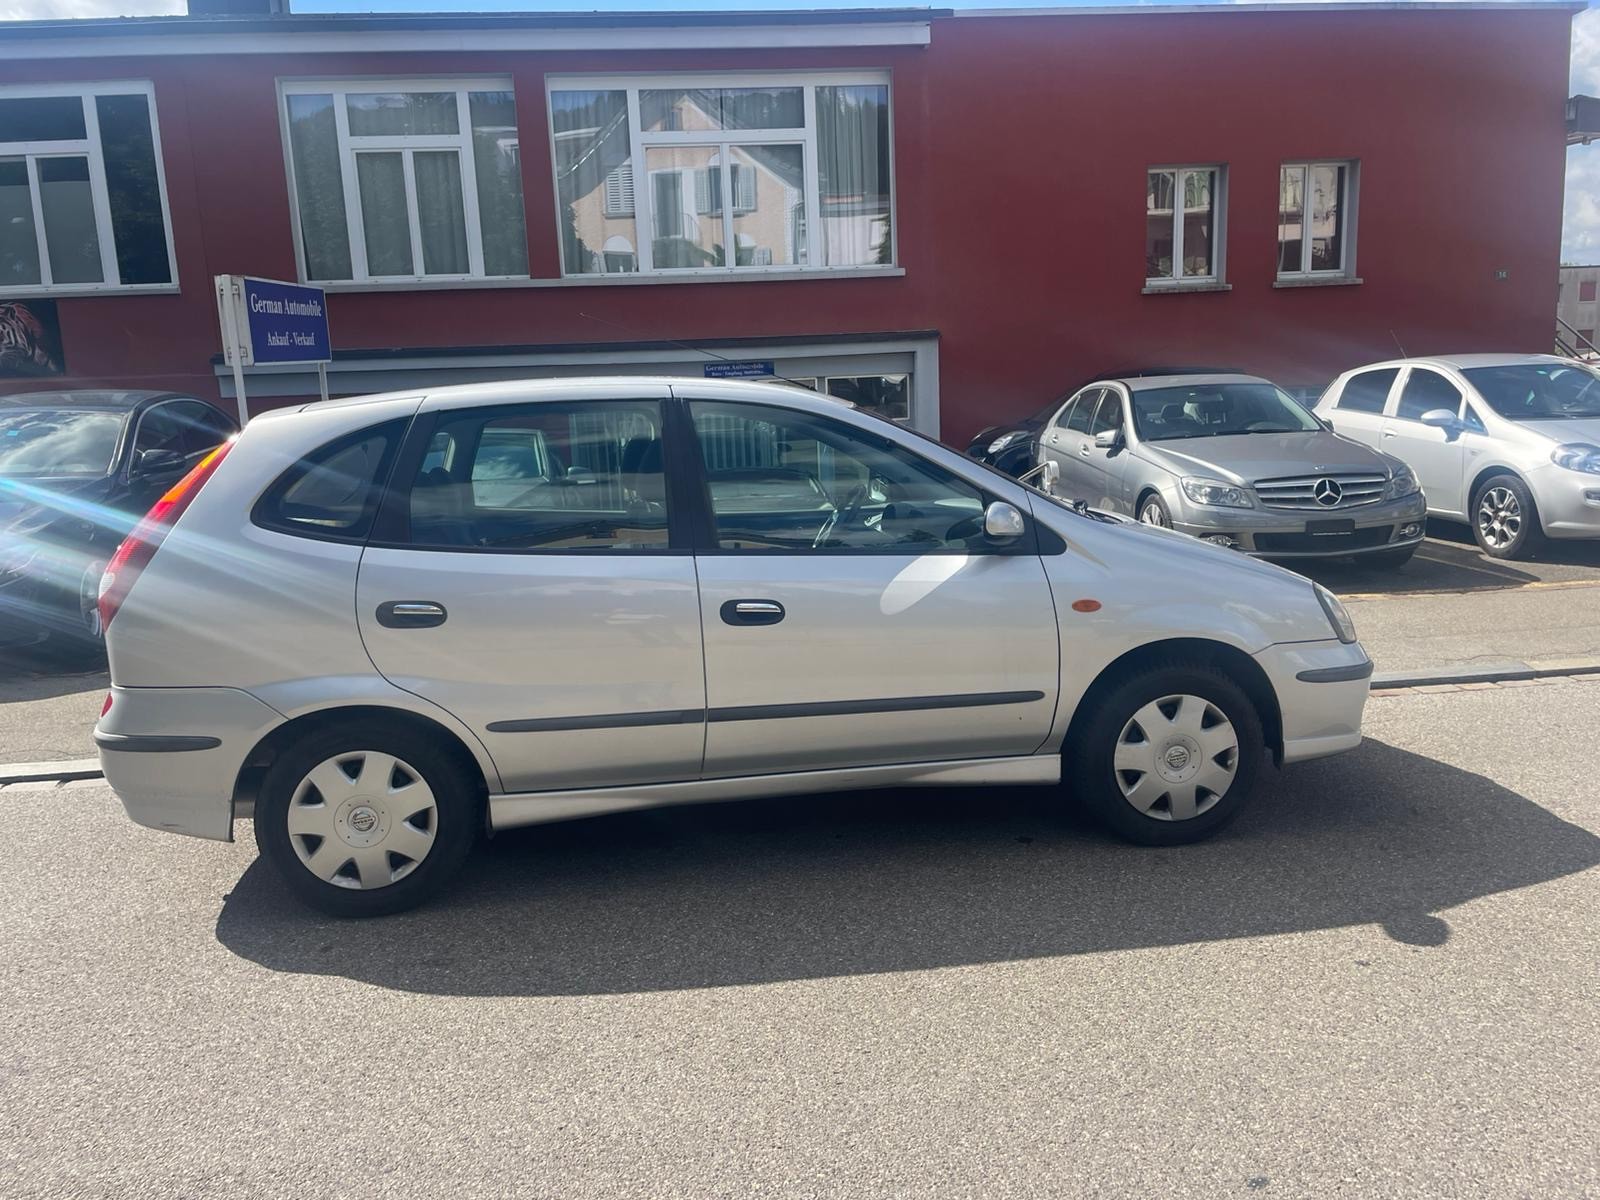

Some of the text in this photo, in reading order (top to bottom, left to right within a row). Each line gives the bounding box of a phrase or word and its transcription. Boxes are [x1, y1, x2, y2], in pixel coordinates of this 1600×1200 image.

[251, 293, 322, 317] German Automobile
[268, 331, 289, 346] Ankauf
[293, 331, 315, 346] Verkauf
